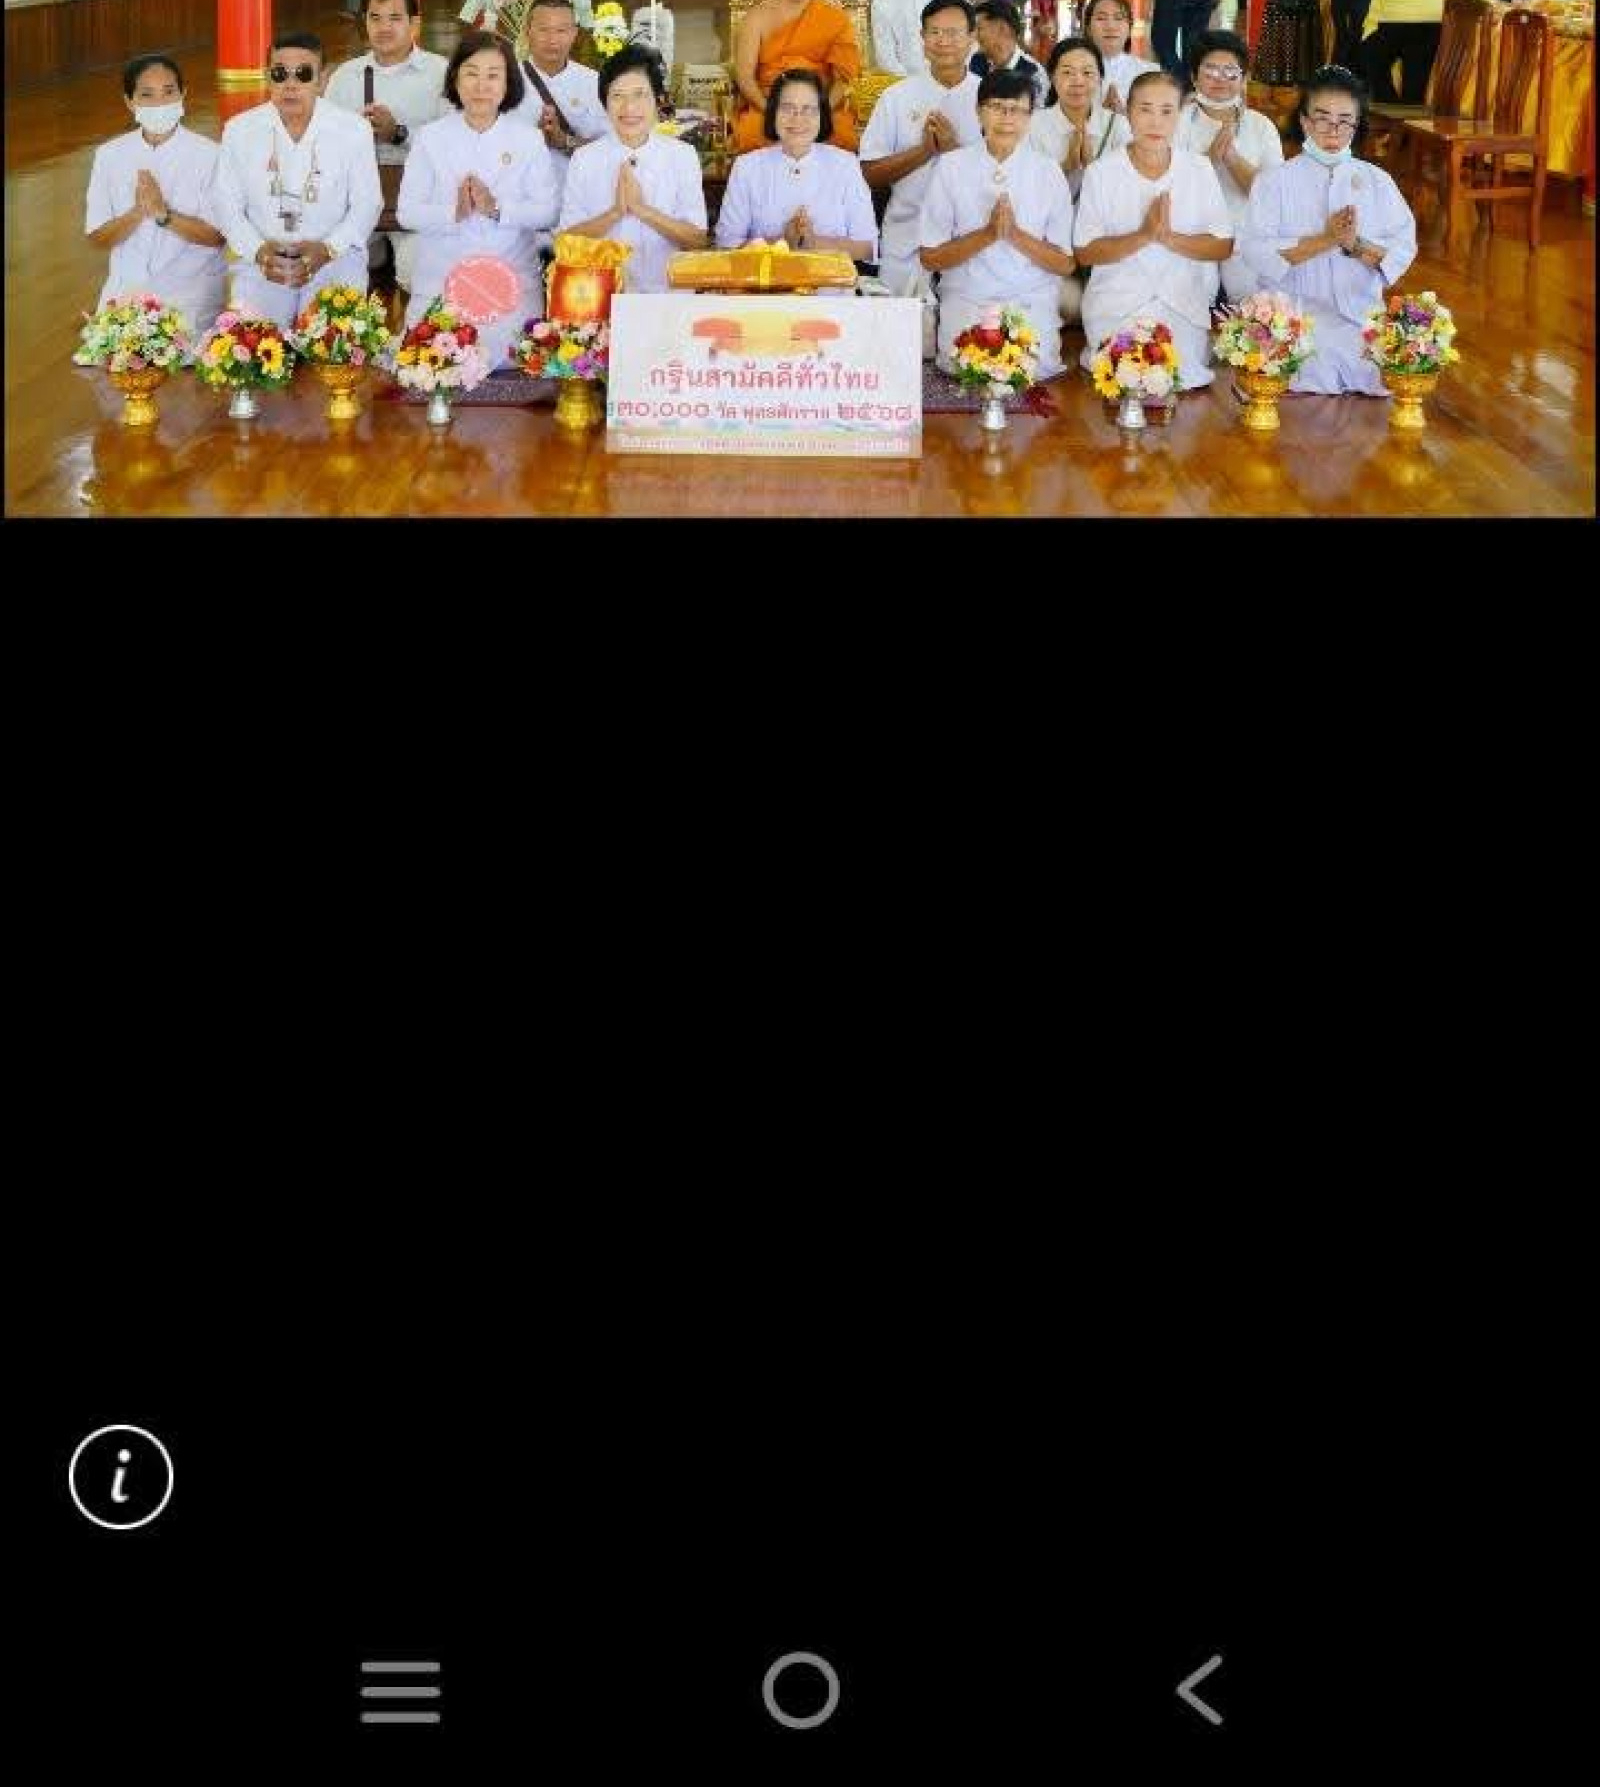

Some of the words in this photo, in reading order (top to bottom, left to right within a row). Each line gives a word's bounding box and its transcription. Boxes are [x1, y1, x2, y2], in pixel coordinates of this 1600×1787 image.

[649, 355, 879, 394] กฐินสามัคคีทั่วไทย
